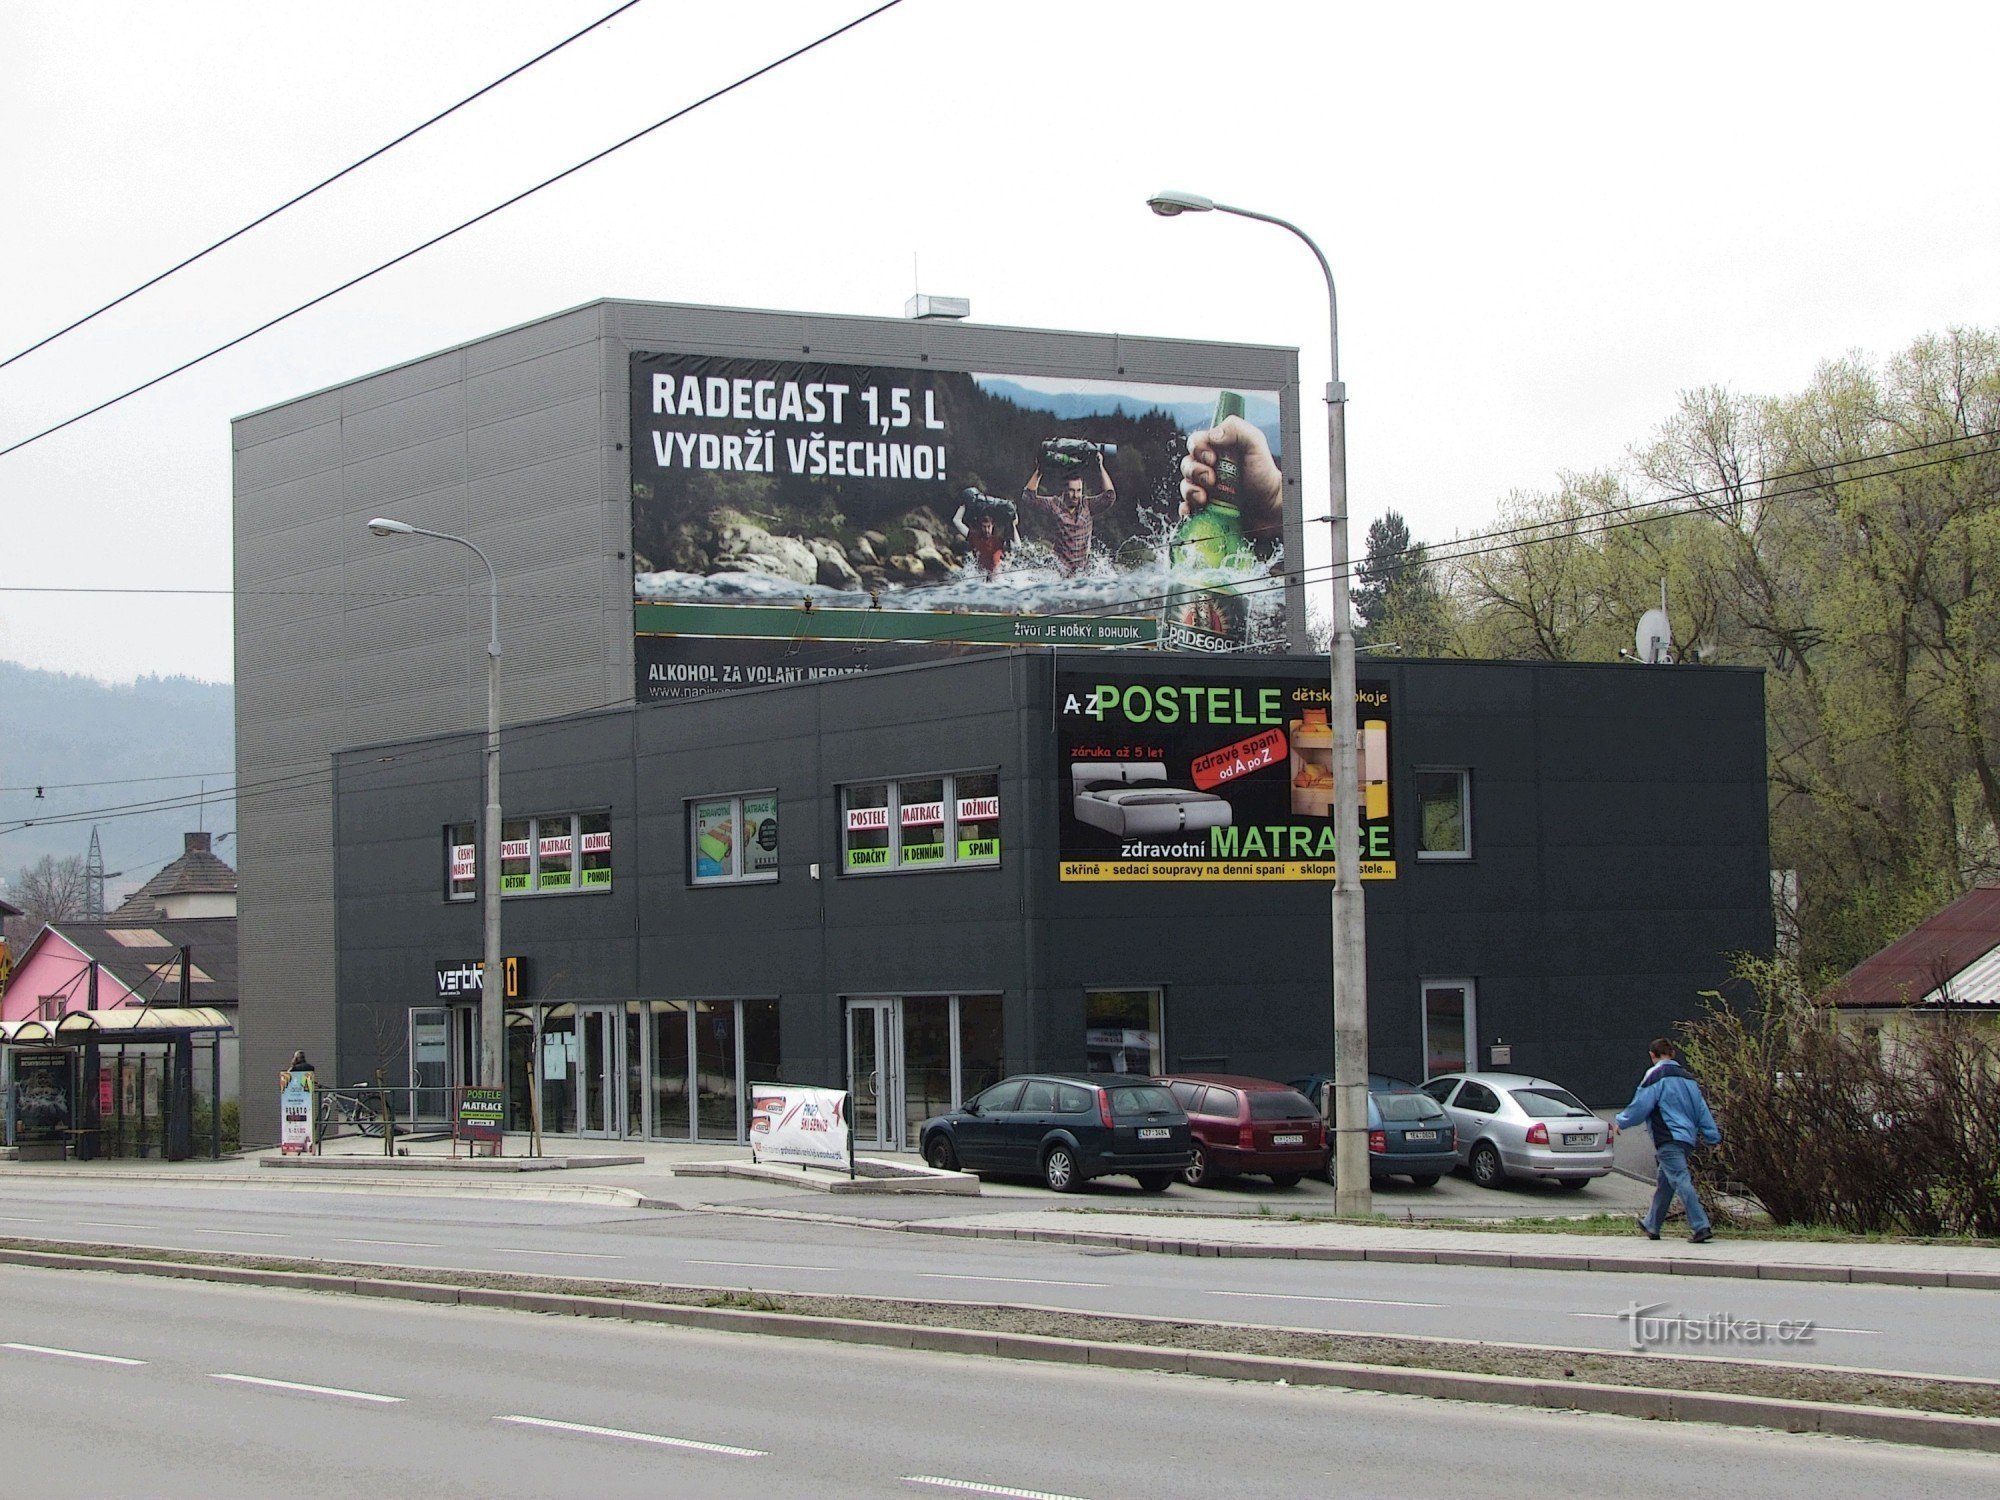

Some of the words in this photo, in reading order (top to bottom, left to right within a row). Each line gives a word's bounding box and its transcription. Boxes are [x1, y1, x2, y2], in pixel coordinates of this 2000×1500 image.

[652, 373, 849, 424] RADEGAST
[861, 386, 911, 436] 1,5
[925, 390, 945, 430] L
[652, 428, 776, 472] VYDRŽÍ
[786, 431, 946, 481] VŠECHNO!
[1045, 625, 1056, 637] JE
[1060, 623, 1094, 638] HOŘKÝ.
[1098, 624, 1142, 639] BOHUDÍK.
[649, 663, 719, 682] ALKOHOL
[723, 665, 742, 683] ZA
[747, 666, 804, 684] VOLANT
[1096, 685, 1282, 725] POSTELE
[1071, 745, 1111, 757] záruka
[1116, 746, 1130, 757] až
[1134, 747, 1143, 758] 5
[1147, 747, 1164, 758] let
[1194, 746, 1239, 773] zdravé
[1242, 730, 1279, 755] spaní
[1220, 766, 1233, 779] od
[1235, 759, 1246, 774] A
[1247, 757, 1261, 773] po
[1261, 748, 1272, 763] Z
[850, 810, 886, 826] POSTELE
[902, 806, 940, 822] MATRACE
[962, 799, 998, 816] LOŽNICE
[502, 842, 528, 856] POSTELE
[540, 838, 572, 853] MATRACE
[585, 833, 611, 850] LOŽNICE
[852, 848, 887, 865] SEDAČKY
[904, 847, 909, 861] K
[911, 844, 944, 860] DENNÍMU
[969, 839, 994, 856] SPANÍ
[1121, 841, 1206, 858] zdravotní
[1065, 864, 1100, 875] skřině
[1152, 865, 1203, 877] soupravy
[1206, 866, 1219, 875] na
[1300, 864, 1336, 876] sklopn
[462, 1101, 503, 1112] MATRACE
[467, 1090, 502, 1100] POSTELE
